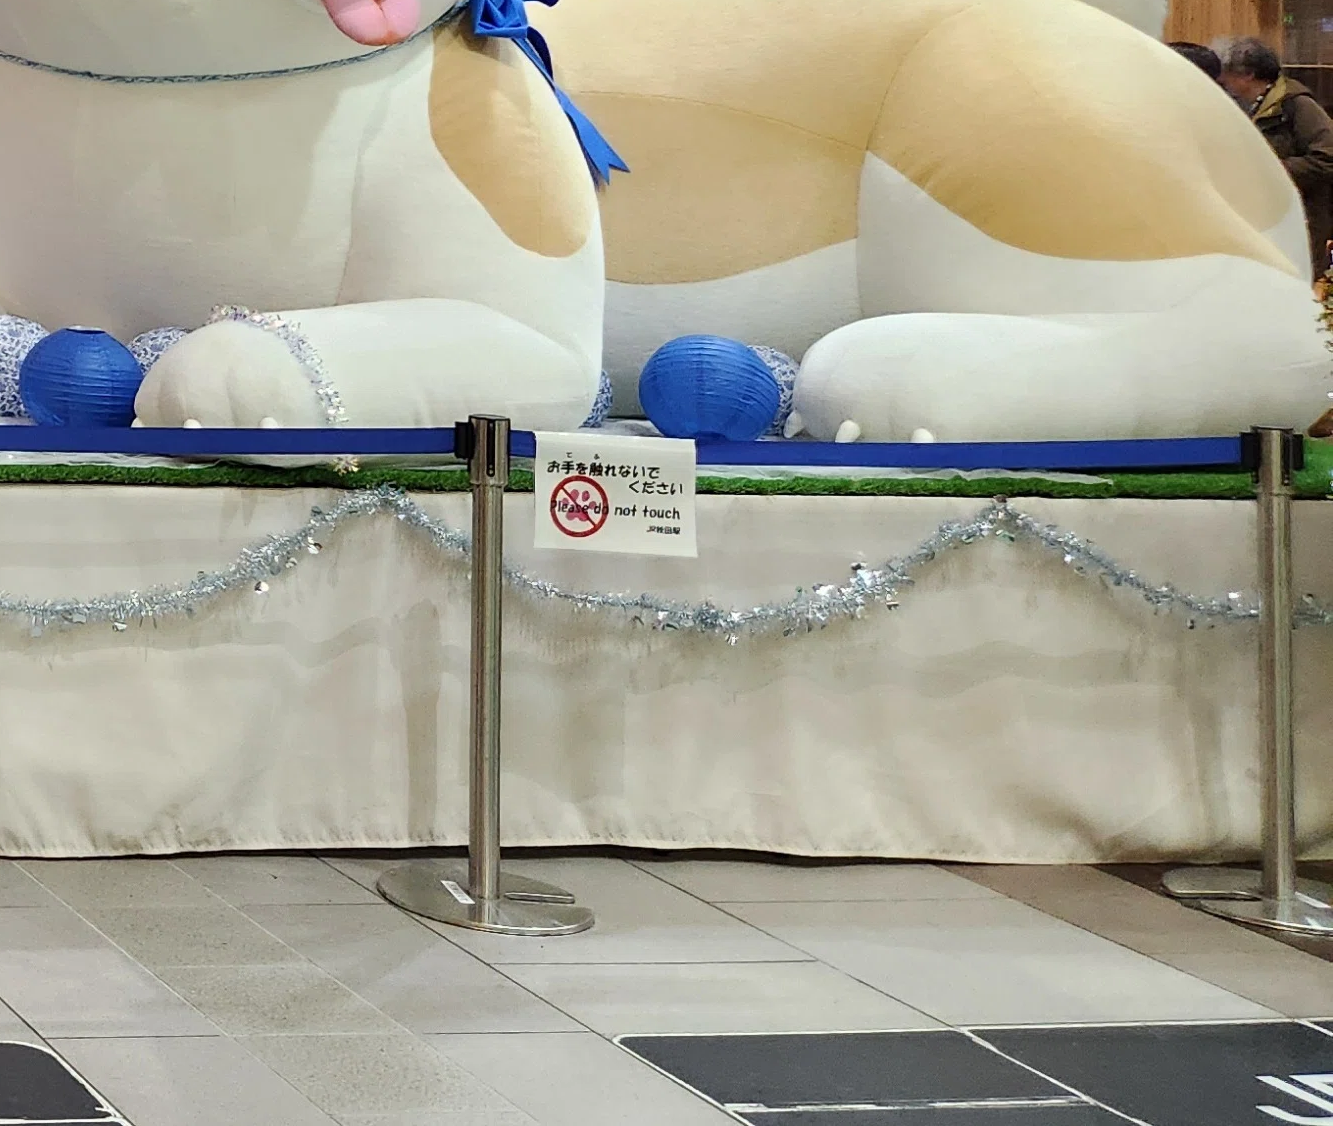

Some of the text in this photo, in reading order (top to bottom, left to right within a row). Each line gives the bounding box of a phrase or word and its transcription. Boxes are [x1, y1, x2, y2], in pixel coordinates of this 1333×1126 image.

[547, 460, 660, 479] お手を触れないで
[628, 481, 683, 495] ください
[550, 499, 590, 514] Please
[614, 504, 637, 517] not
[642, 505, 681, 520] touch
